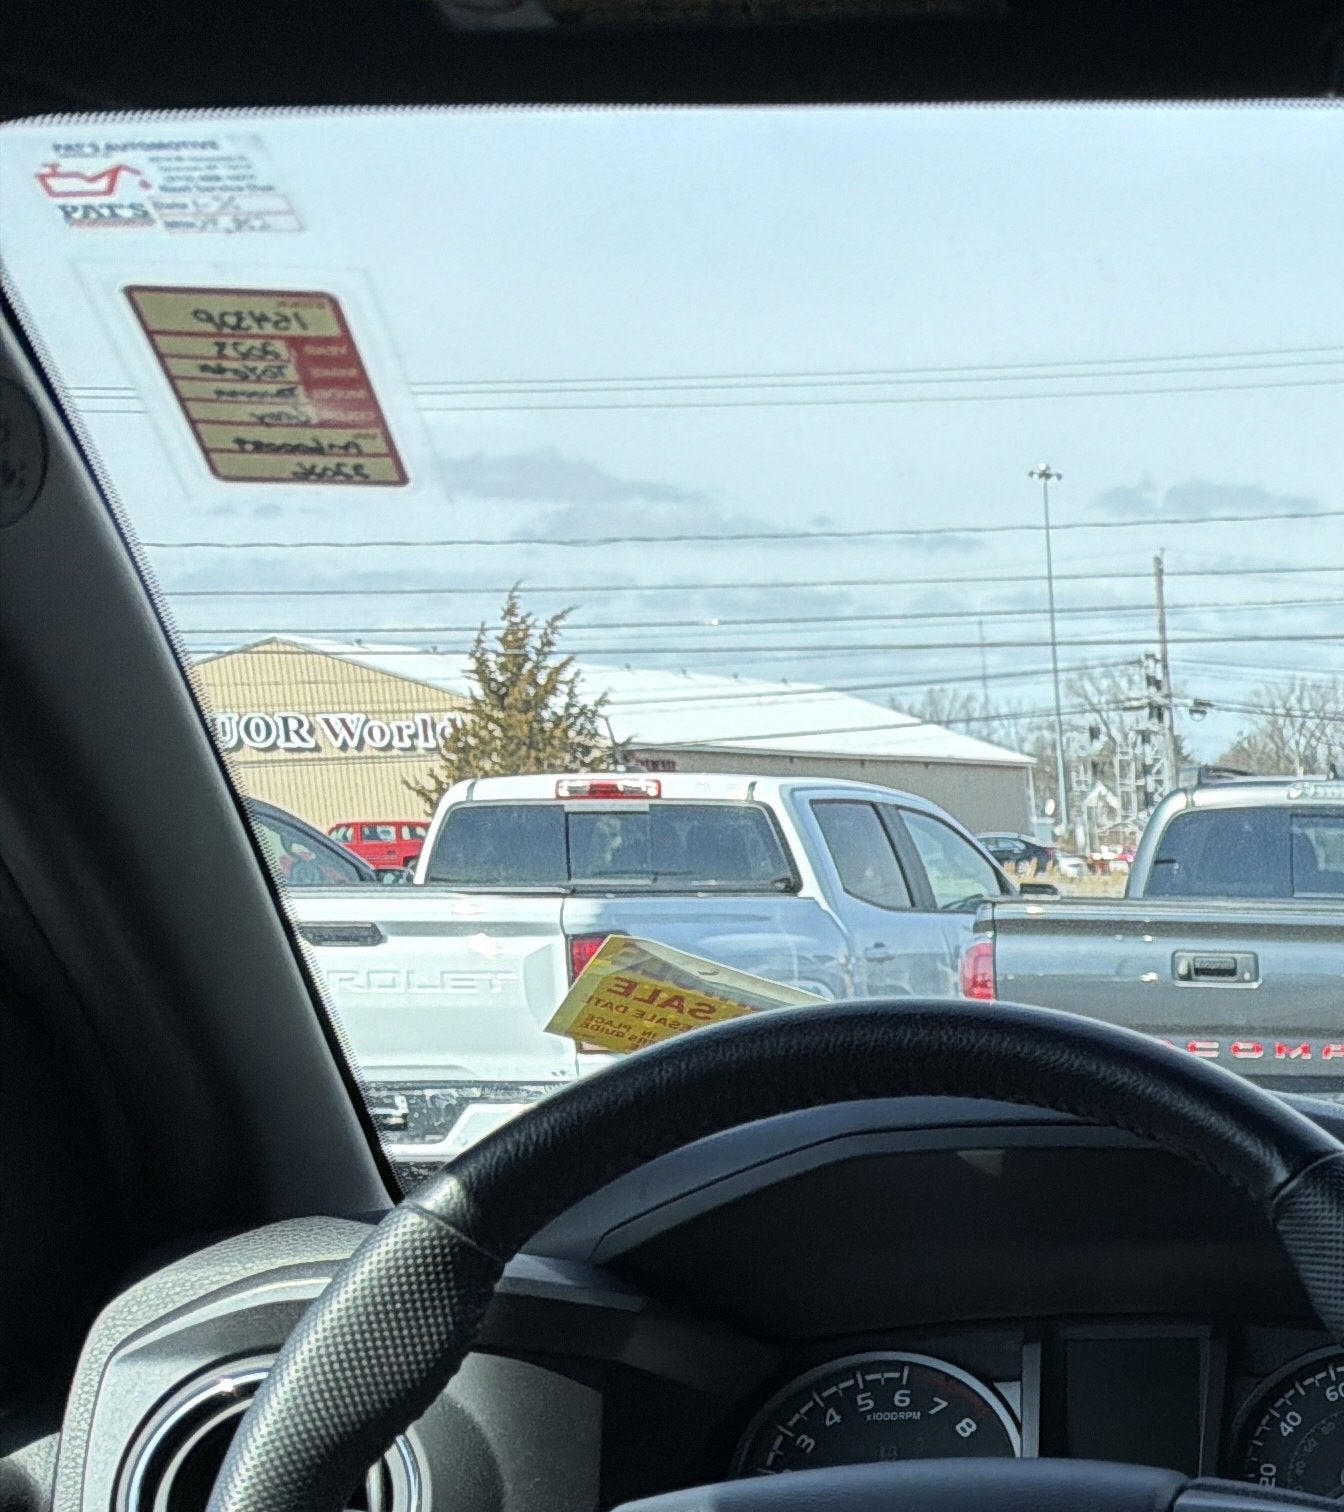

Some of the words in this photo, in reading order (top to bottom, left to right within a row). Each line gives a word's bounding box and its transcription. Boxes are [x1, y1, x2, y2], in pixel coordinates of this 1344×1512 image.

[855, 1391, 875, 1414] 5
[892, 1388, 912, 1408] 6
[927, 1396, 950, 1416] 7
[824, 1406, 843, 1429] 4
[953, 1416, 979, 1439] 8
[1278, 1410, 1303, 1438] 40
[795, 1432, 817, 1455] 3
